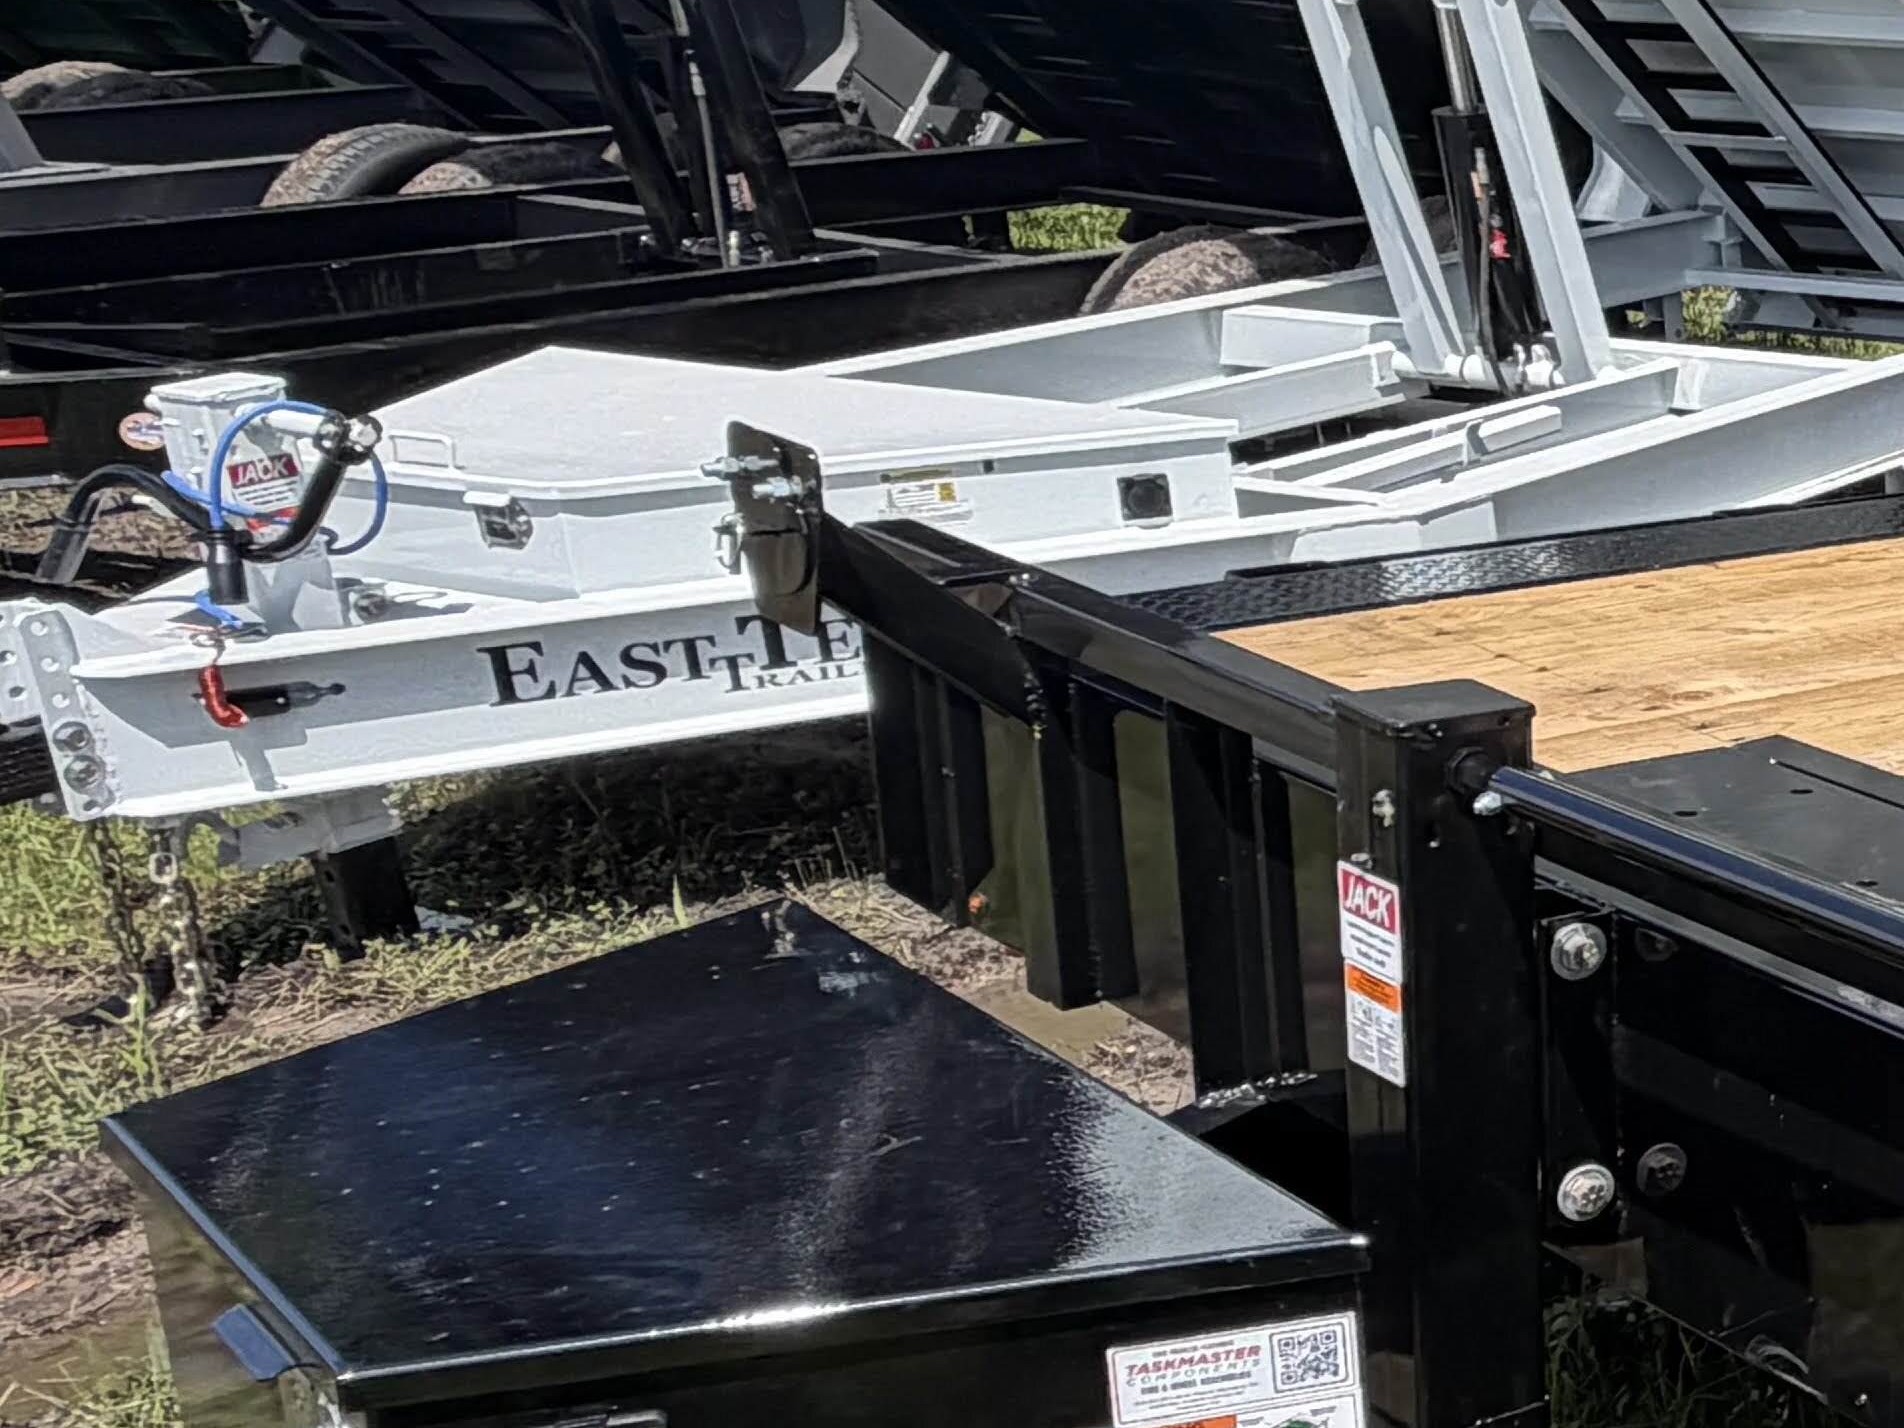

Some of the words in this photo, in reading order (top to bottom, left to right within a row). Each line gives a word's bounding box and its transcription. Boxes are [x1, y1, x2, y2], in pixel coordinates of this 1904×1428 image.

[235, 456, 289, 485] JACK
[476, 633, 716, 707] EAST
[1344, 874, 1393, 928] JACK
[1124, 1344, 1262, 1377] TASKMASTER
[1125, 1359, 1261, 1388] COMPONENTS
